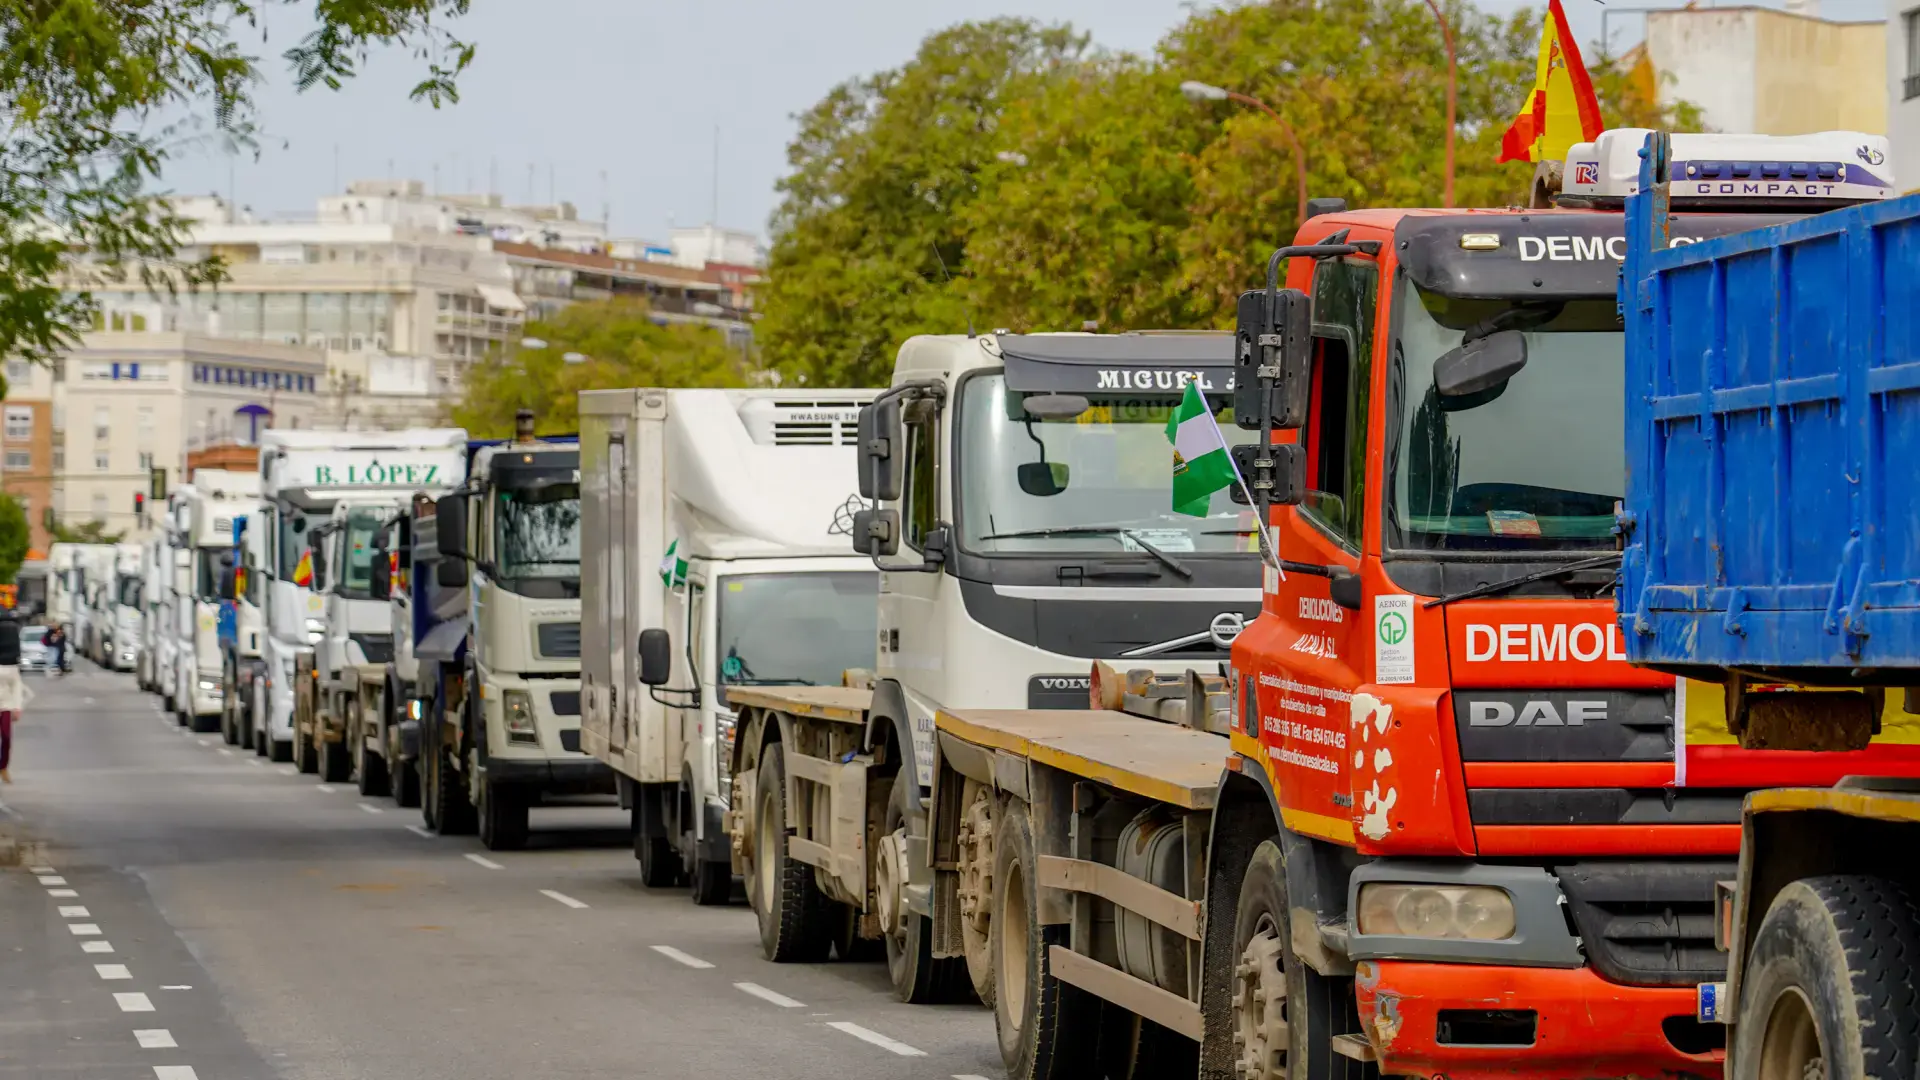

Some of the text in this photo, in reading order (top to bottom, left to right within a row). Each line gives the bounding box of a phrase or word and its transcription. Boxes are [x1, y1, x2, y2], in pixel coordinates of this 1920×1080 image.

[1697, 184, 1835, 196] COMPACT
[1518, 236, 1626, 262] DEMO
[1097, 370, 1213, 390] MIGUEL
[790, 413, 858, 421] HWASUNG TH
[315, 464, 339, 486] B.
[1299, 597, 1343, 624] DEMOLICIONES
[1379, 600, 1408, 609] AENOR
[1466, 622, 1627, 662] DEMOL
[1039, 678, 1091, 689] VOLV
[1469, 701, 1607, 727] DAF
